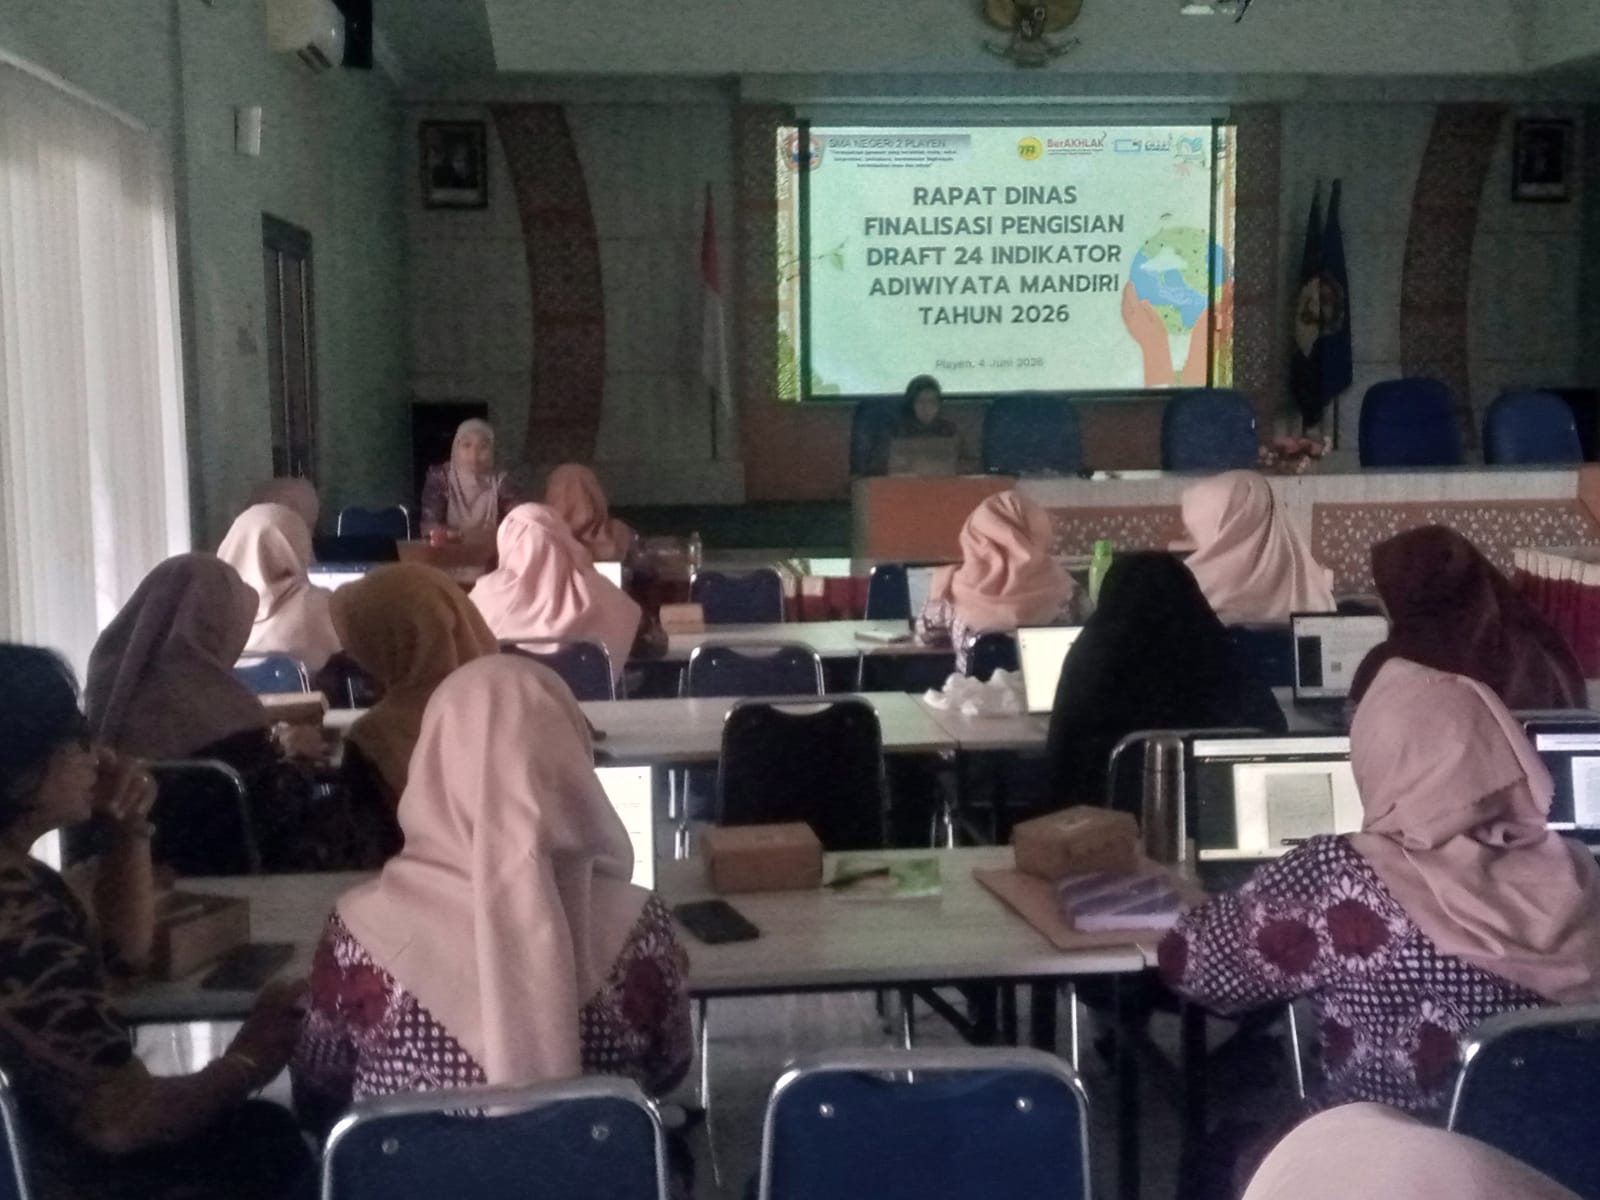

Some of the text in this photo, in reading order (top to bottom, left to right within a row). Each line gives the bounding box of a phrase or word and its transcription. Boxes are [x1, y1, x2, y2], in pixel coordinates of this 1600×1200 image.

[913, 185, 1078, 206] RAPAT DINAS
[864, 214, 1124, 236] FINALISASI PENGISIAN
[866, 244, 1122, 266] DRAFT 24 INDIKATOR
[869, 274, 1119, 296] ADIWIYATA MANDIRI
[918, 304, 1070, 326] TAHUN 2026
